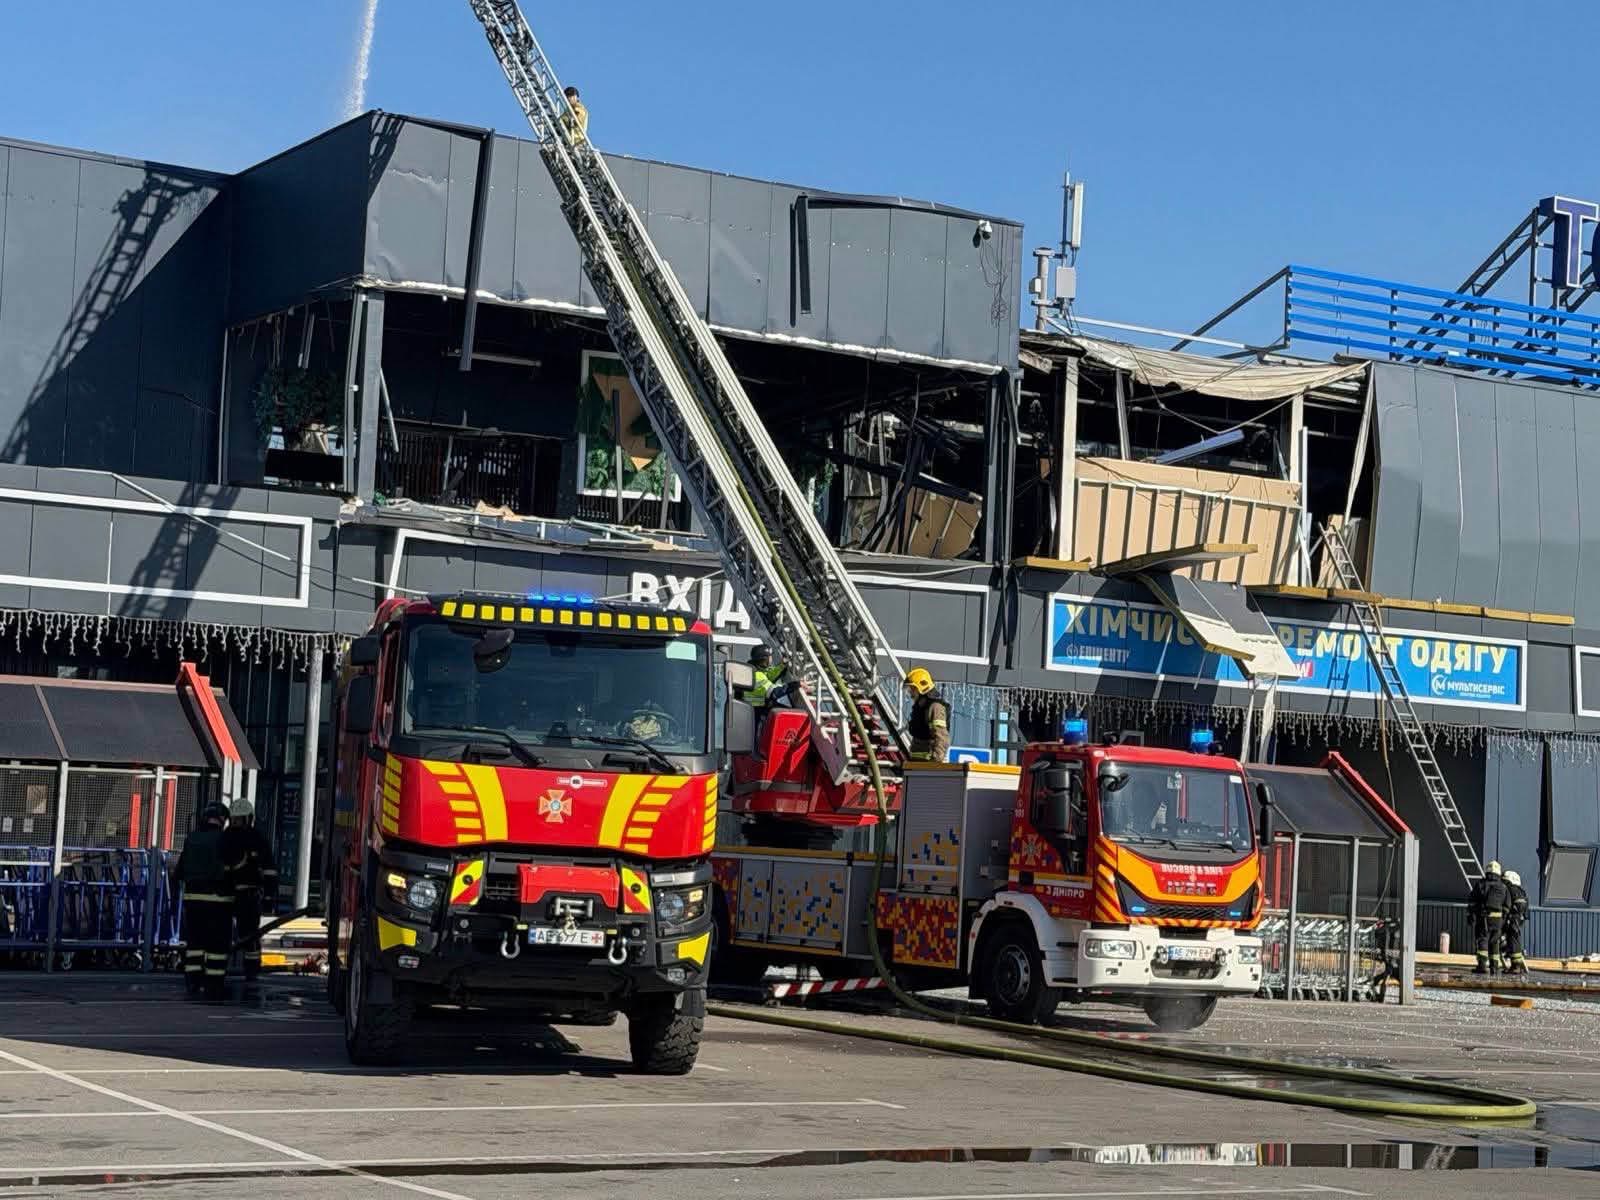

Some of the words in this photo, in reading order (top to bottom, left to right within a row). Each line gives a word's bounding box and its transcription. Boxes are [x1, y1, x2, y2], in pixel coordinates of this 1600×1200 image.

[1538, 195, 1600, 290] Т
[632, 571, 750, 630] ВХІД
[1066, 603, 1196, 646] ХІМЧИС
[1411, 639, 1507, 674] ОДЯГУ
[1447, 680, 1505, 695] МУЛЬТИСЕРВІС
[1052, 887, 1085, 898] ДНІПРО
